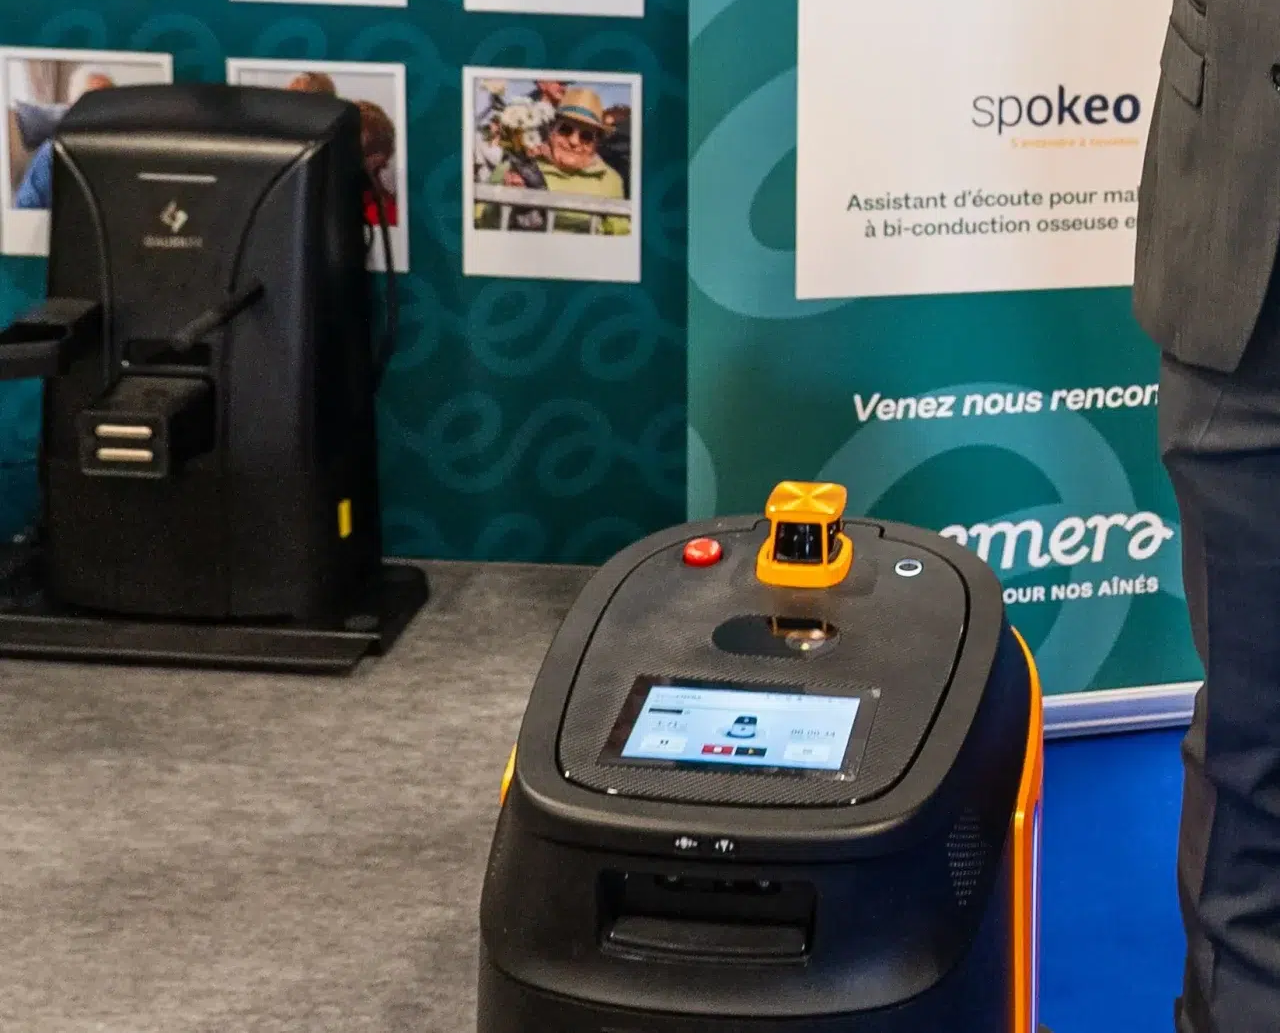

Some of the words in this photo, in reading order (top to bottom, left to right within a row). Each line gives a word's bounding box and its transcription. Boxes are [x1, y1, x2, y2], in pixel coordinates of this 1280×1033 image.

[971, 84, 1141, 135] spokeo
[847, 190, 947, 213] Assistant
[1049, 191, 1098, 210] pour
[864, 220, 877, 238] à
[883, 216, 1031, 238] bi-conduction
[1036, 216, 1119, 233] osseuse
[853, 392, 956, 423] Venez
[962, 388, 1042, 417] nous
[1051, 582, 1094, 600] NOS
[1098, 574, 1160, 597] AÎNÉS
